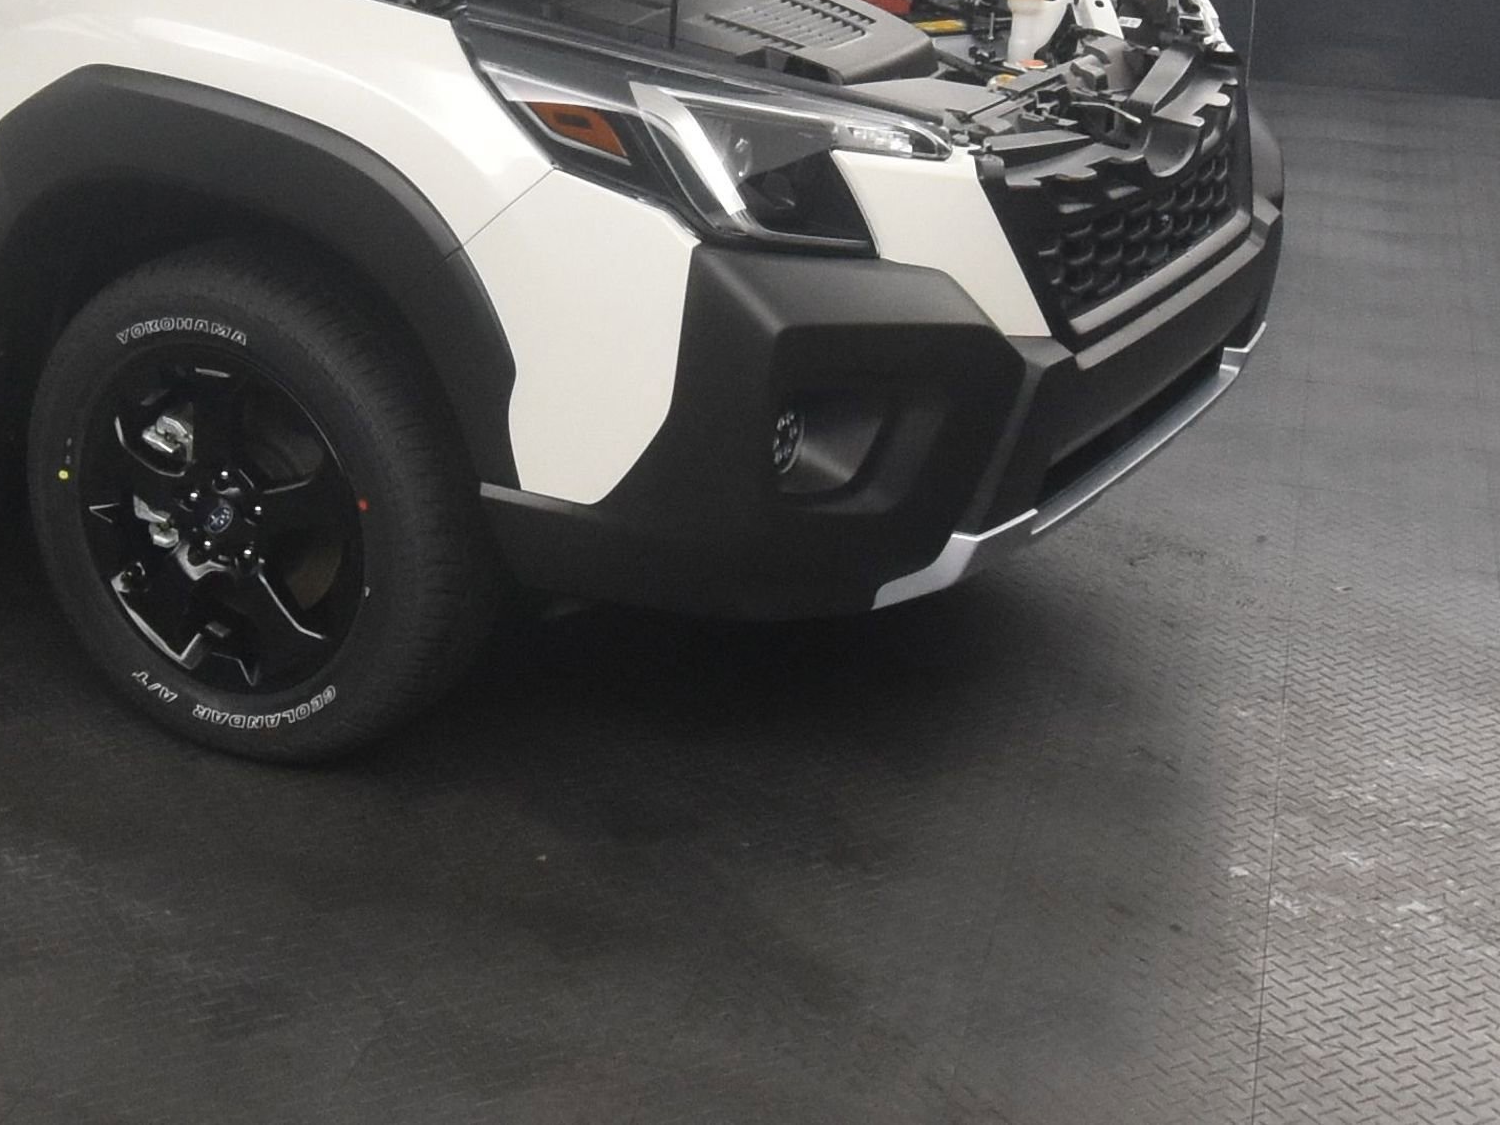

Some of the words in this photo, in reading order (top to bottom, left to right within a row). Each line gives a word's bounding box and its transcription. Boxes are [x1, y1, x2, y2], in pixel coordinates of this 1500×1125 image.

[115, 317, 247, 346] YOKOHAMA
[131, 670, 179, 703] A/T
[192, 684, 337, 729] GEOLANDAR
